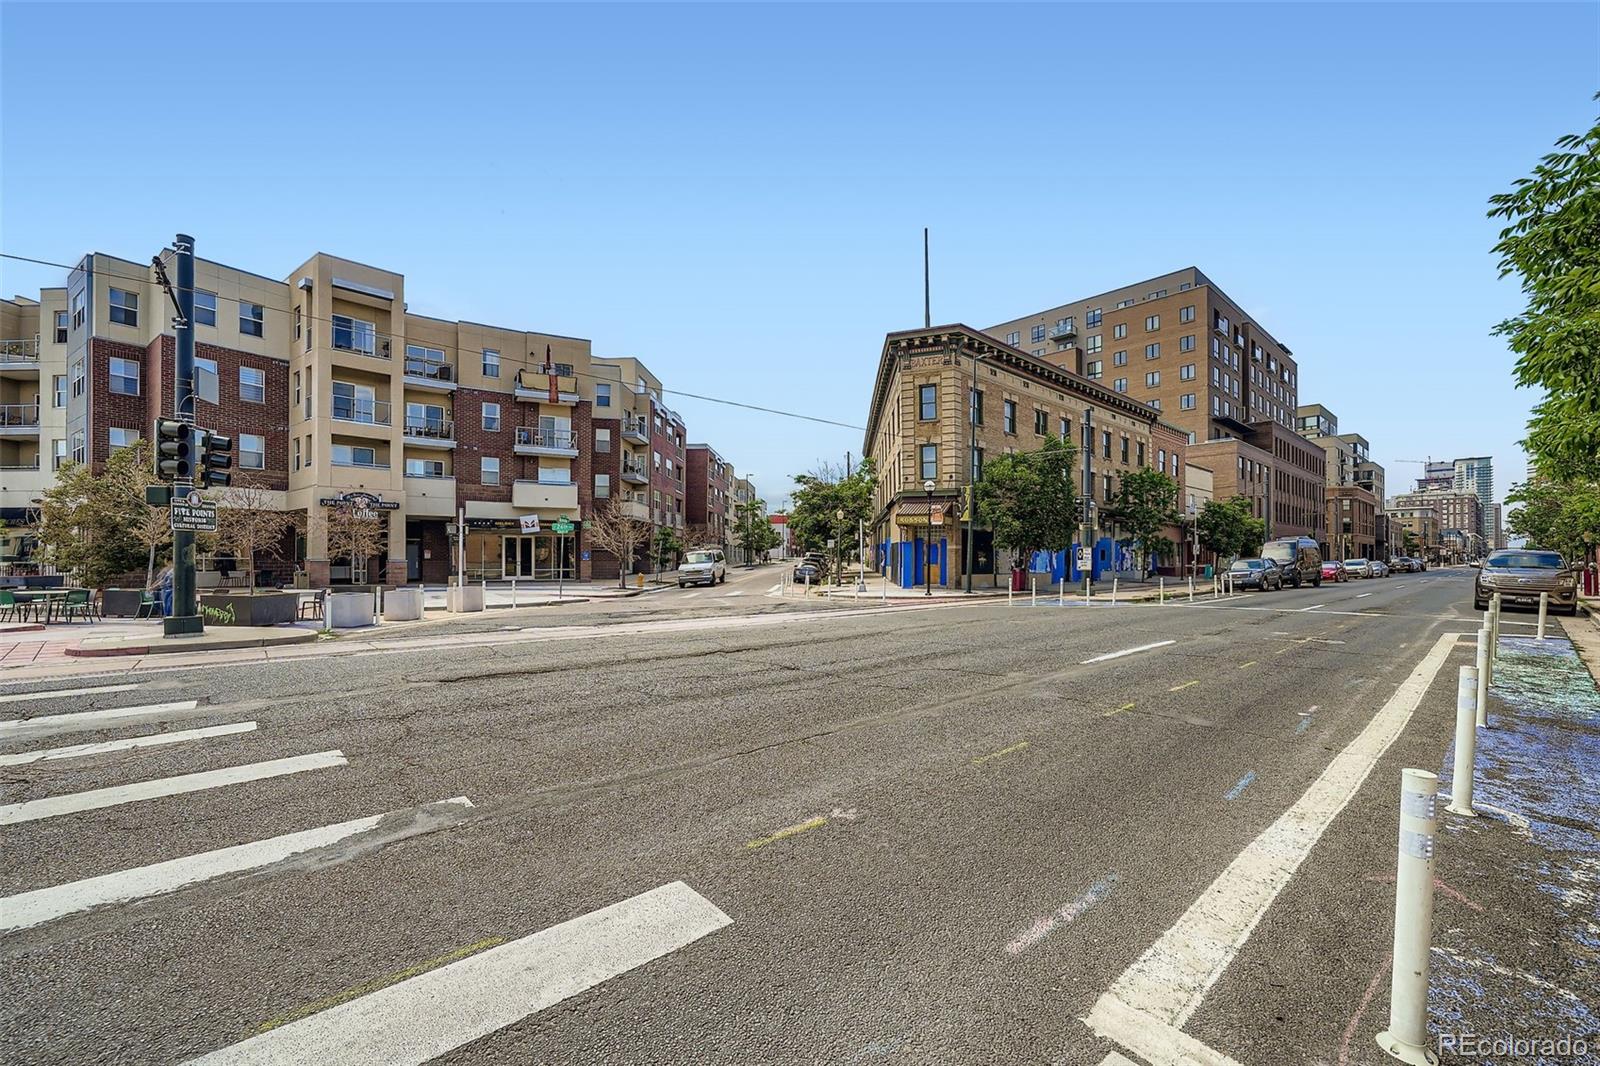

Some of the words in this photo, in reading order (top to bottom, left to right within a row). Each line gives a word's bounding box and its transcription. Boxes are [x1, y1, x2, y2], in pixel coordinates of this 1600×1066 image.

[173, 507, 191, 516] FIVE
[191, 509, 215, 518] POINTS
[352, 508, 378, 519] Coffee
